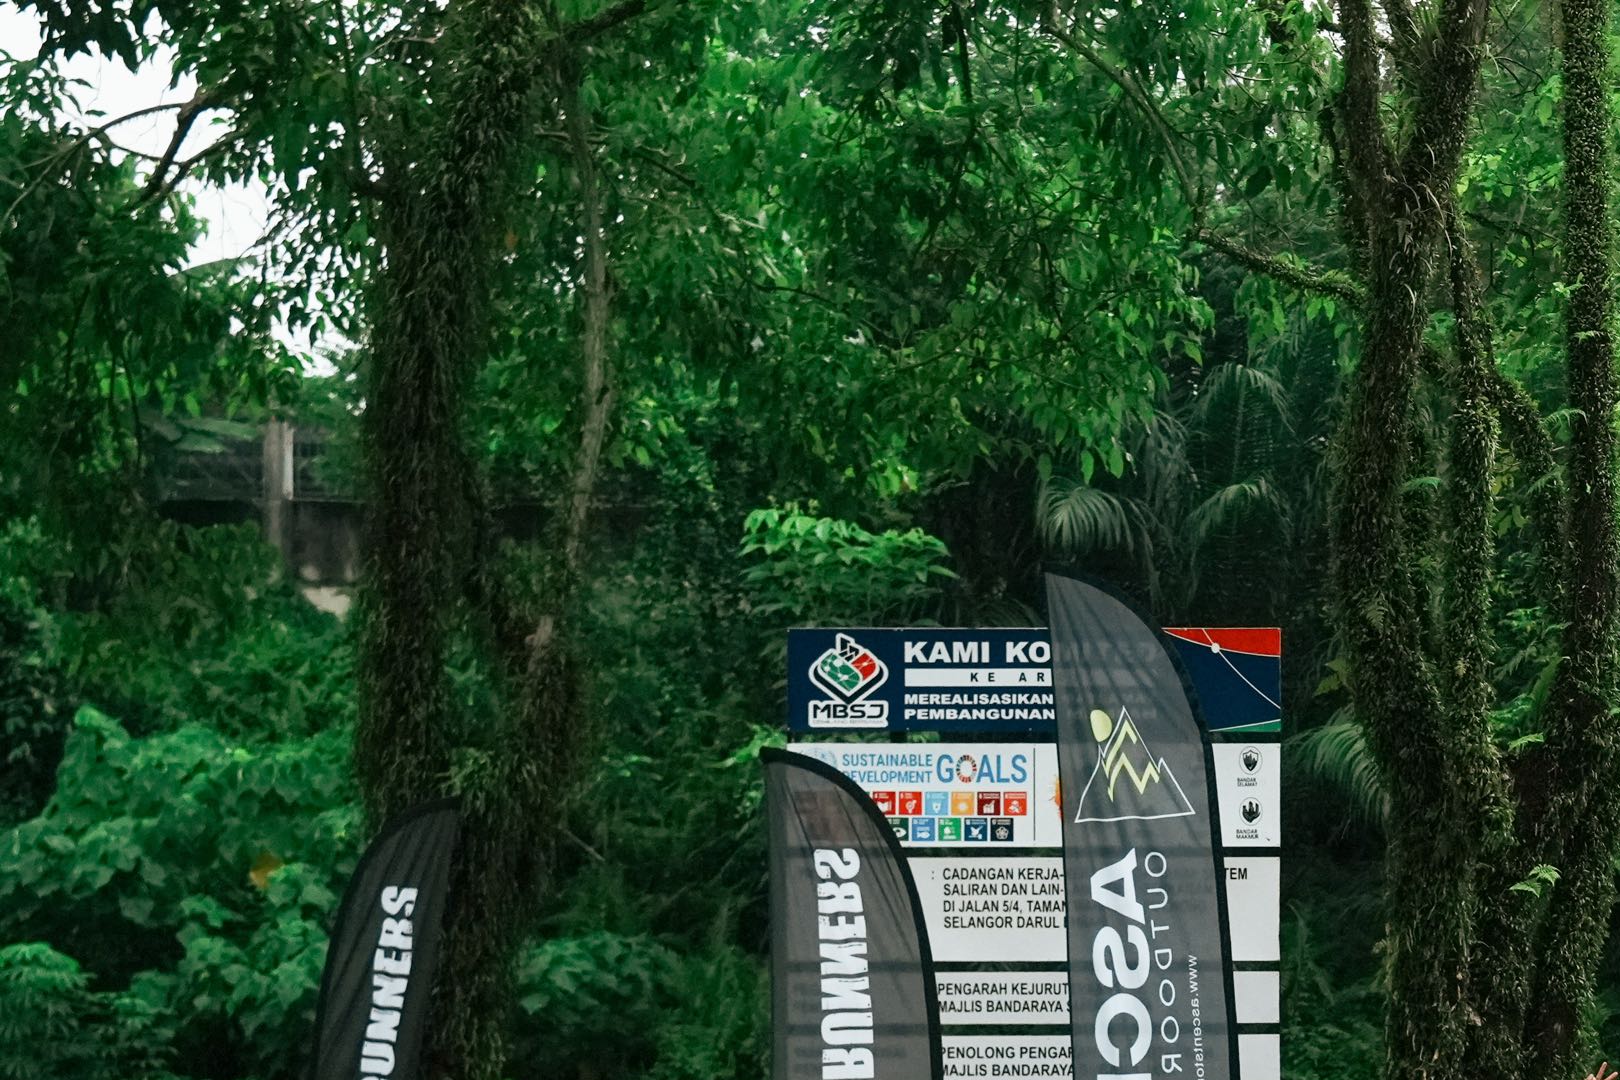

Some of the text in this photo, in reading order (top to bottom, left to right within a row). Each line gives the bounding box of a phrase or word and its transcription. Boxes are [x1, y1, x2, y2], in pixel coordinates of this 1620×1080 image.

[904, 641, 990, 663] KAMI
[970, 672, 996, 682] KE
[904, 694, 1054, 705] MEREALISASIKAN
[812, 704, 885, 719] MBSJ
[904, 709, 1056, 720] PEMBANGUNAN
[842, 754, 933, 768] SUSTAINABLE
[943, 868, 1014, 880] CADANGAN
[944, 884, 998, 896] SALIRAN
[1001, 884, 1027, 896] DAN
[943, 901, 955, 912] DI
[959, 901, 999, 912] JALAN
[1003, 901, 1023, 914] 5/4,
[944, 917, 1013, 928] SELANGOR
[1017, 917, 1060, 928] DARUL
[938, 983, 1007, 995] PENGARAH
[939, 1001, 982, 1012] MAJLIS
[986, 1001, 1063, 1012] BANDARAYA
